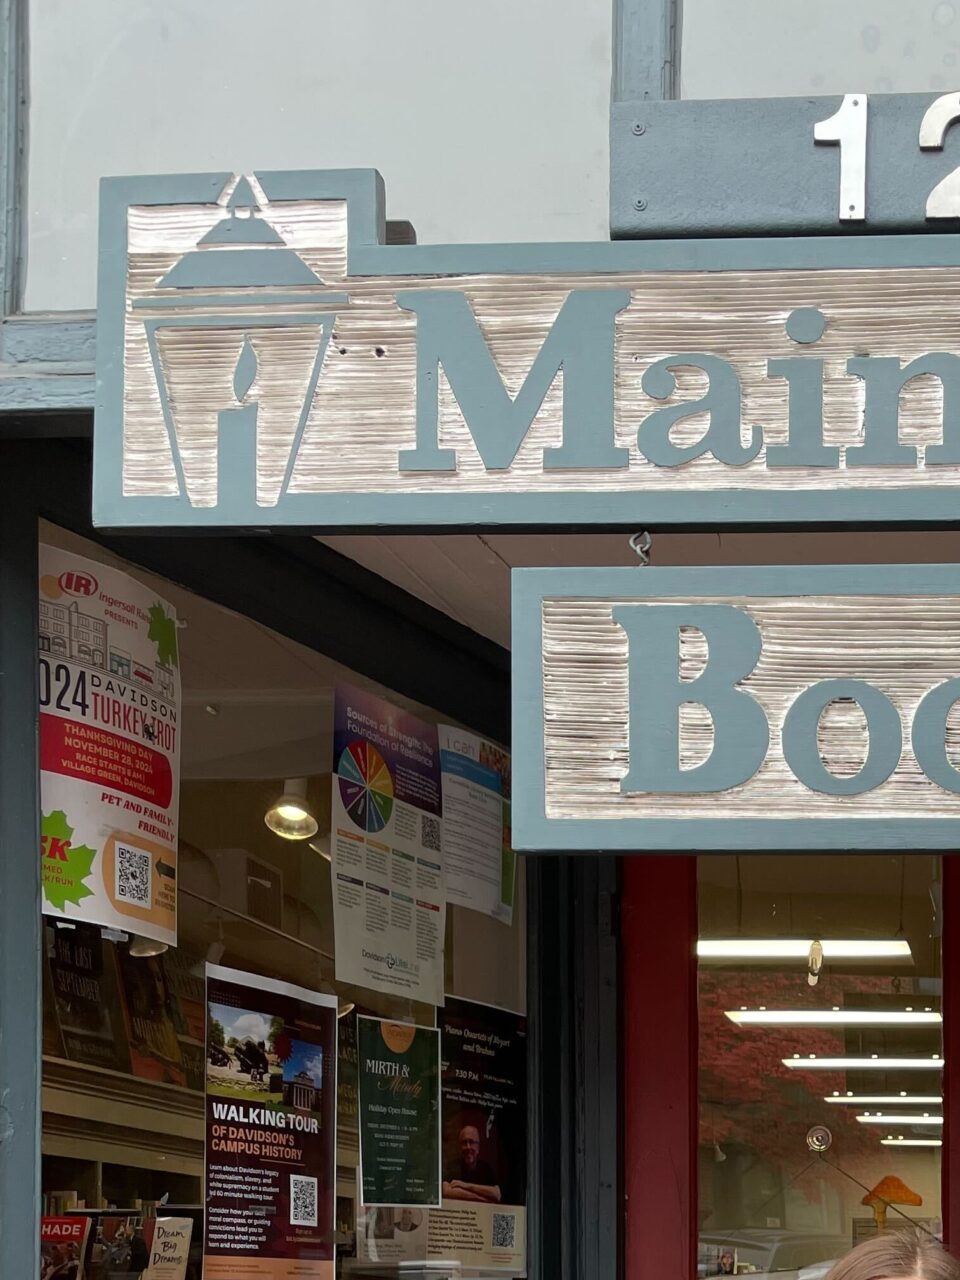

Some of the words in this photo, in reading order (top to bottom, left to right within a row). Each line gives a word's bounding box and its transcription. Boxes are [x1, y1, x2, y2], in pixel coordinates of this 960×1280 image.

[64, 571, 92, 597] IR
[99, 591, 136, 614] Ingersoll
[104, 608, 139, 630] PRESENTS
[39, 658, 89, 717] 024
[91, 673, 177, 724] DAVIDSON
[91, 691, 148, 740] TURKEY
[346, 706, 378, 731] Sources
[64, 722, 137, 755] THANKSGIVING
[138, 747, 154, 762] DAY
[346, 718, 390, 748] Foundation
[64, 736, 120, 760] NOVEMBER
[75, 752, 98, 766] RACE
[61, 758, 97, 777] VILLAGE
[123, 777, 156, 796] DAVIDSON
[100, 791, 123, 808] PET
[123, 799, 142, 815] AND
[143, 806, 175, 828] FAMILY-
[137, 819, 176, 844] FRIENDLY
[365, 1058, 400, 1077] MIRTH
[212, 1102, 286, 1129] WALKING
[286, 1112, 319, 1134] TOUR
[211, 1124, 228, 1138] OF
[228, 1125, 295, 1147] DAVIDSON'S
[211, 1138, 260, 1156] CAMPUS
[261, 1144, 303, 1161] HISTORY
[156, 1225, 186, 1240] Dream
[160, 1240, 178, 1252] Big
[152, 1252, 184, 1266] Dreams
